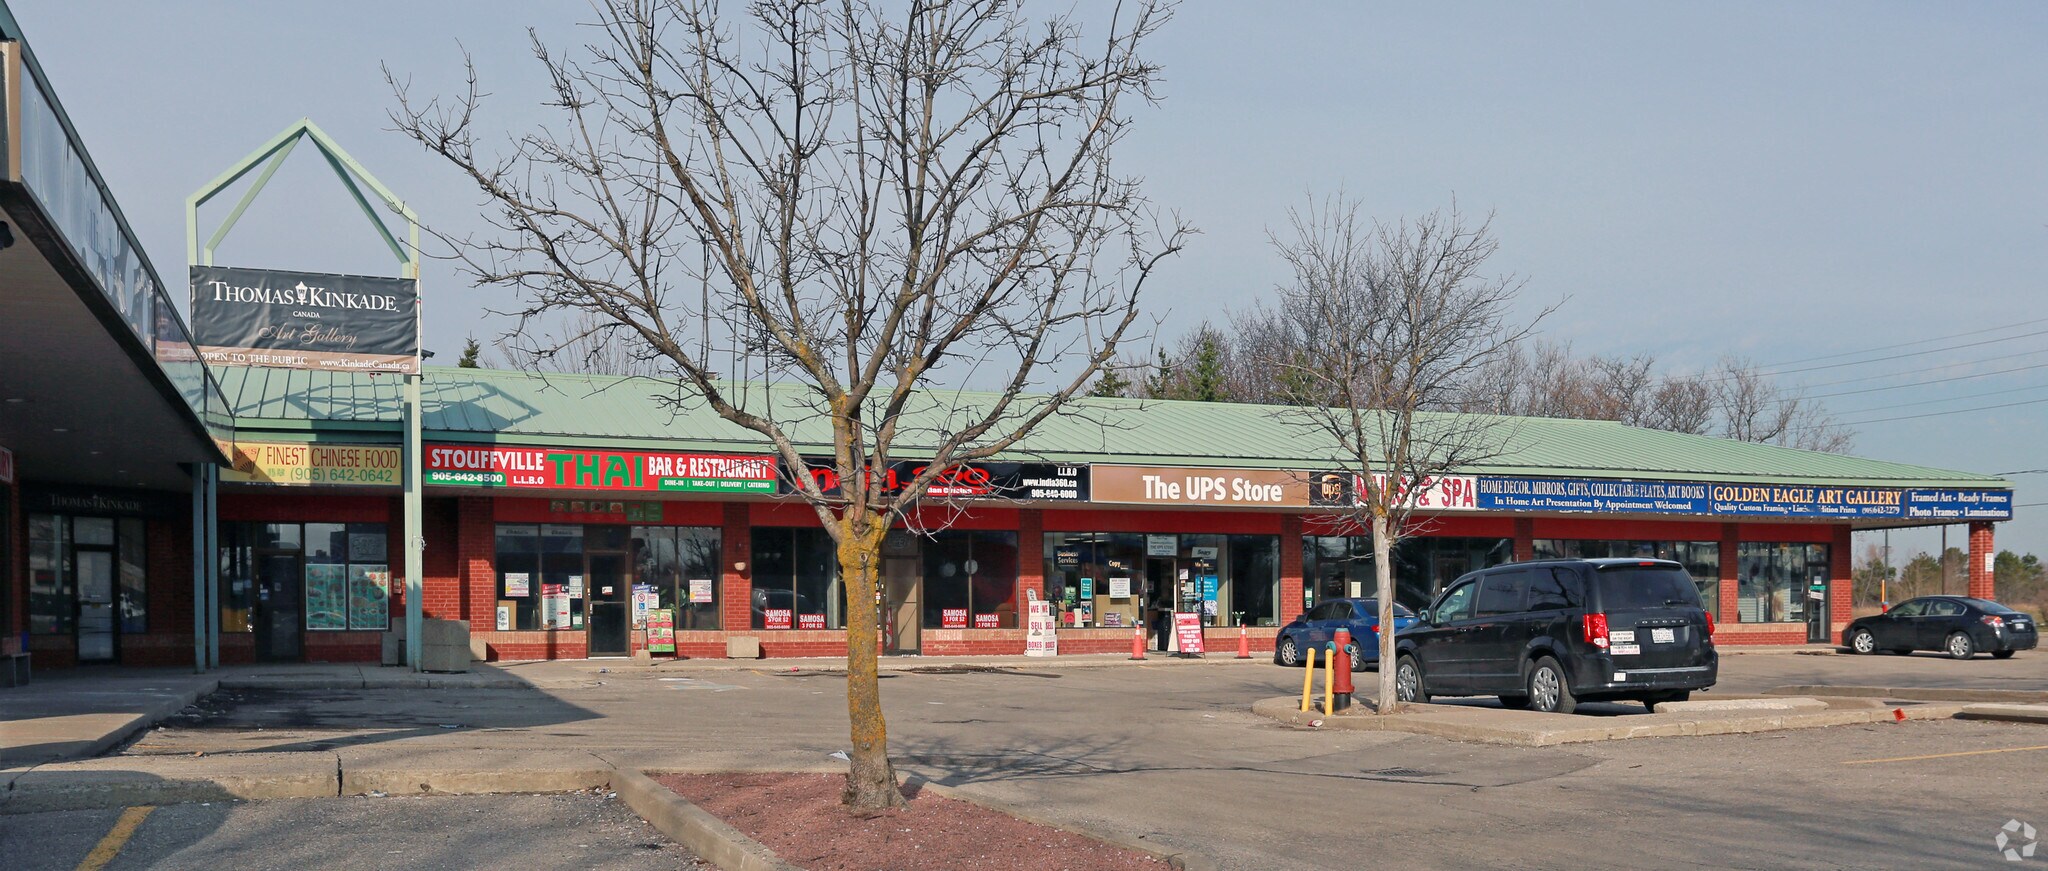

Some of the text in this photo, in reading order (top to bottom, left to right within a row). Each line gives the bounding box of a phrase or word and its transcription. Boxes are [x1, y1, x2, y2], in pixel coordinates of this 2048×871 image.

[209, 281, 397, 311] THOMAS KINKADE
[293, 310, 320, 318] CANADA
[258, 323, 357, 349] Art Gallery
[201, 352, 308, 365] OPEN TO THE PUBLIC
[319, 358, 410, 371] www.KinkadeCanada.ca
[266, 446, 306, 466] FINEST
[311, 448, 360, 468] CHINESE
[365, 450, 398, 469] FOOD
[432, 448, 769, 487] STOUFFVILLE THAI BAR & RESTAURANT
[290, 468, 326, 482] (905)
[330, 469, 392, 482] 642-0642
[432, 472, 503, 483] 905-642-8500
[664, 479, 684, 487] DINE-IN
[1143, 475, 1282, 501] The UPS Store
[1480, 480, 1503, 493] HOME
[1532, 481, 1567, 497] MIRRORS,
[1568, 482, 1590, 498] GIFTS,
[1591, 483, 1639, 497] COLLECTABLE
[1640, 484, 1666, 499] PLATES,
[1668, 486, 1680, 498] ART
[1682, 485, 1704, 499] BOOKS
[1419, 475, 1432, 506] &
[1441, 477, 1474, 507] SPA
[1714, 486, 1902, 505] GOLDEN EAGLE ART GALLERY
[1495, 496, 1691, 510] In Home Art Presentation By Appointment Welcomed
[1911, 492, 2007, 505] Framed Art Ready Frames
[1714, 503, 1737, 513] Quality
[1739, 503, 1762, 511] Custom
[1763, 504, 1788, 514] Framing
[1840, 506, 1856, 514] Prints
[1909, 506, 2009, 517] Photo Frames Laminations
[1109, 560, 1121, 568] Copy
[1030, 605, 1039, 613] WE
[1031, 622, 1042, 630] SELL
